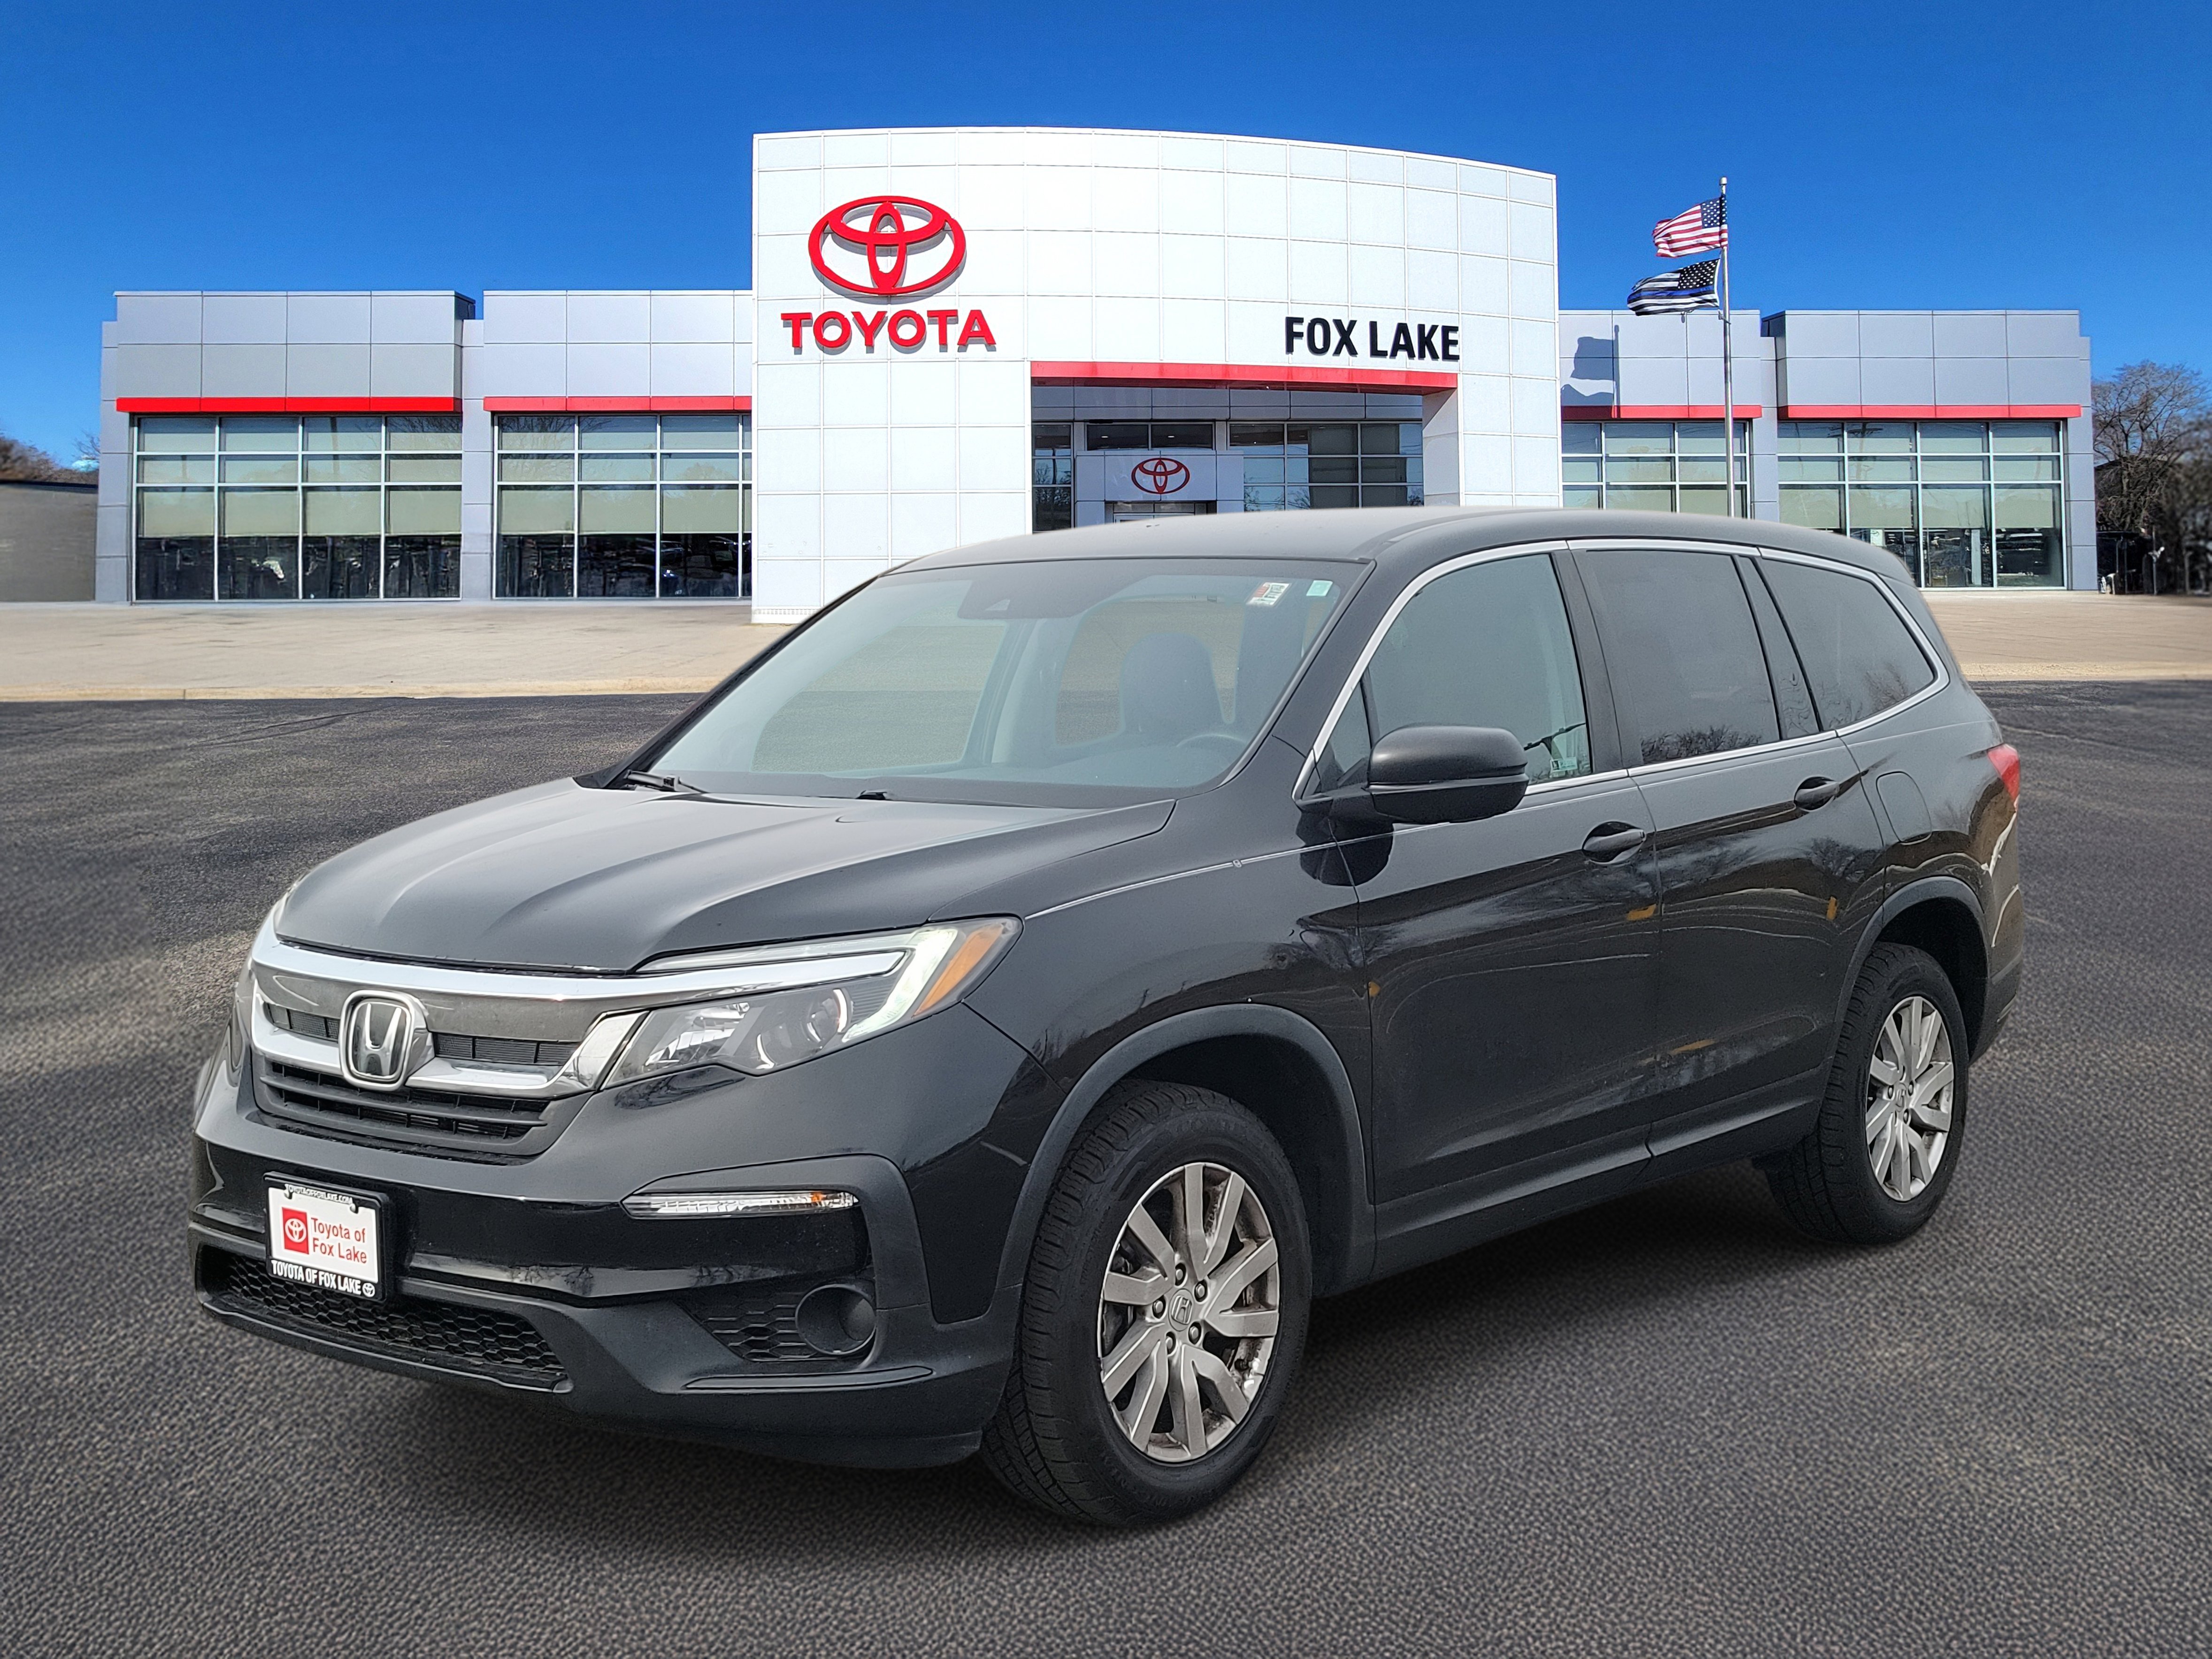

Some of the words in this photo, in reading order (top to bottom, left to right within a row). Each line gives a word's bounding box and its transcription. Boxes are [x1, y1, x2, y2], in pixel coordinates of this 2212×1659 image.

[781, 309, 997, 350] TOYOTA
[1285, 316, 1358, 356] FOX
[1369, 321, 1460, 361] LAKE
[311, 1217, 351, 1239] Toyota
[354, 1228, 366, 1243] of
[312, 1237, 335, 1257] Fox
[338, 1243, 367, 1264] Lake
[271, 1260, 305, 1282] TOYOTA
[305, 1268, 318, 1284] OF
[318, 1271, 337, 1290] FOX
[338, 1275, 361, 1295] LAKE
